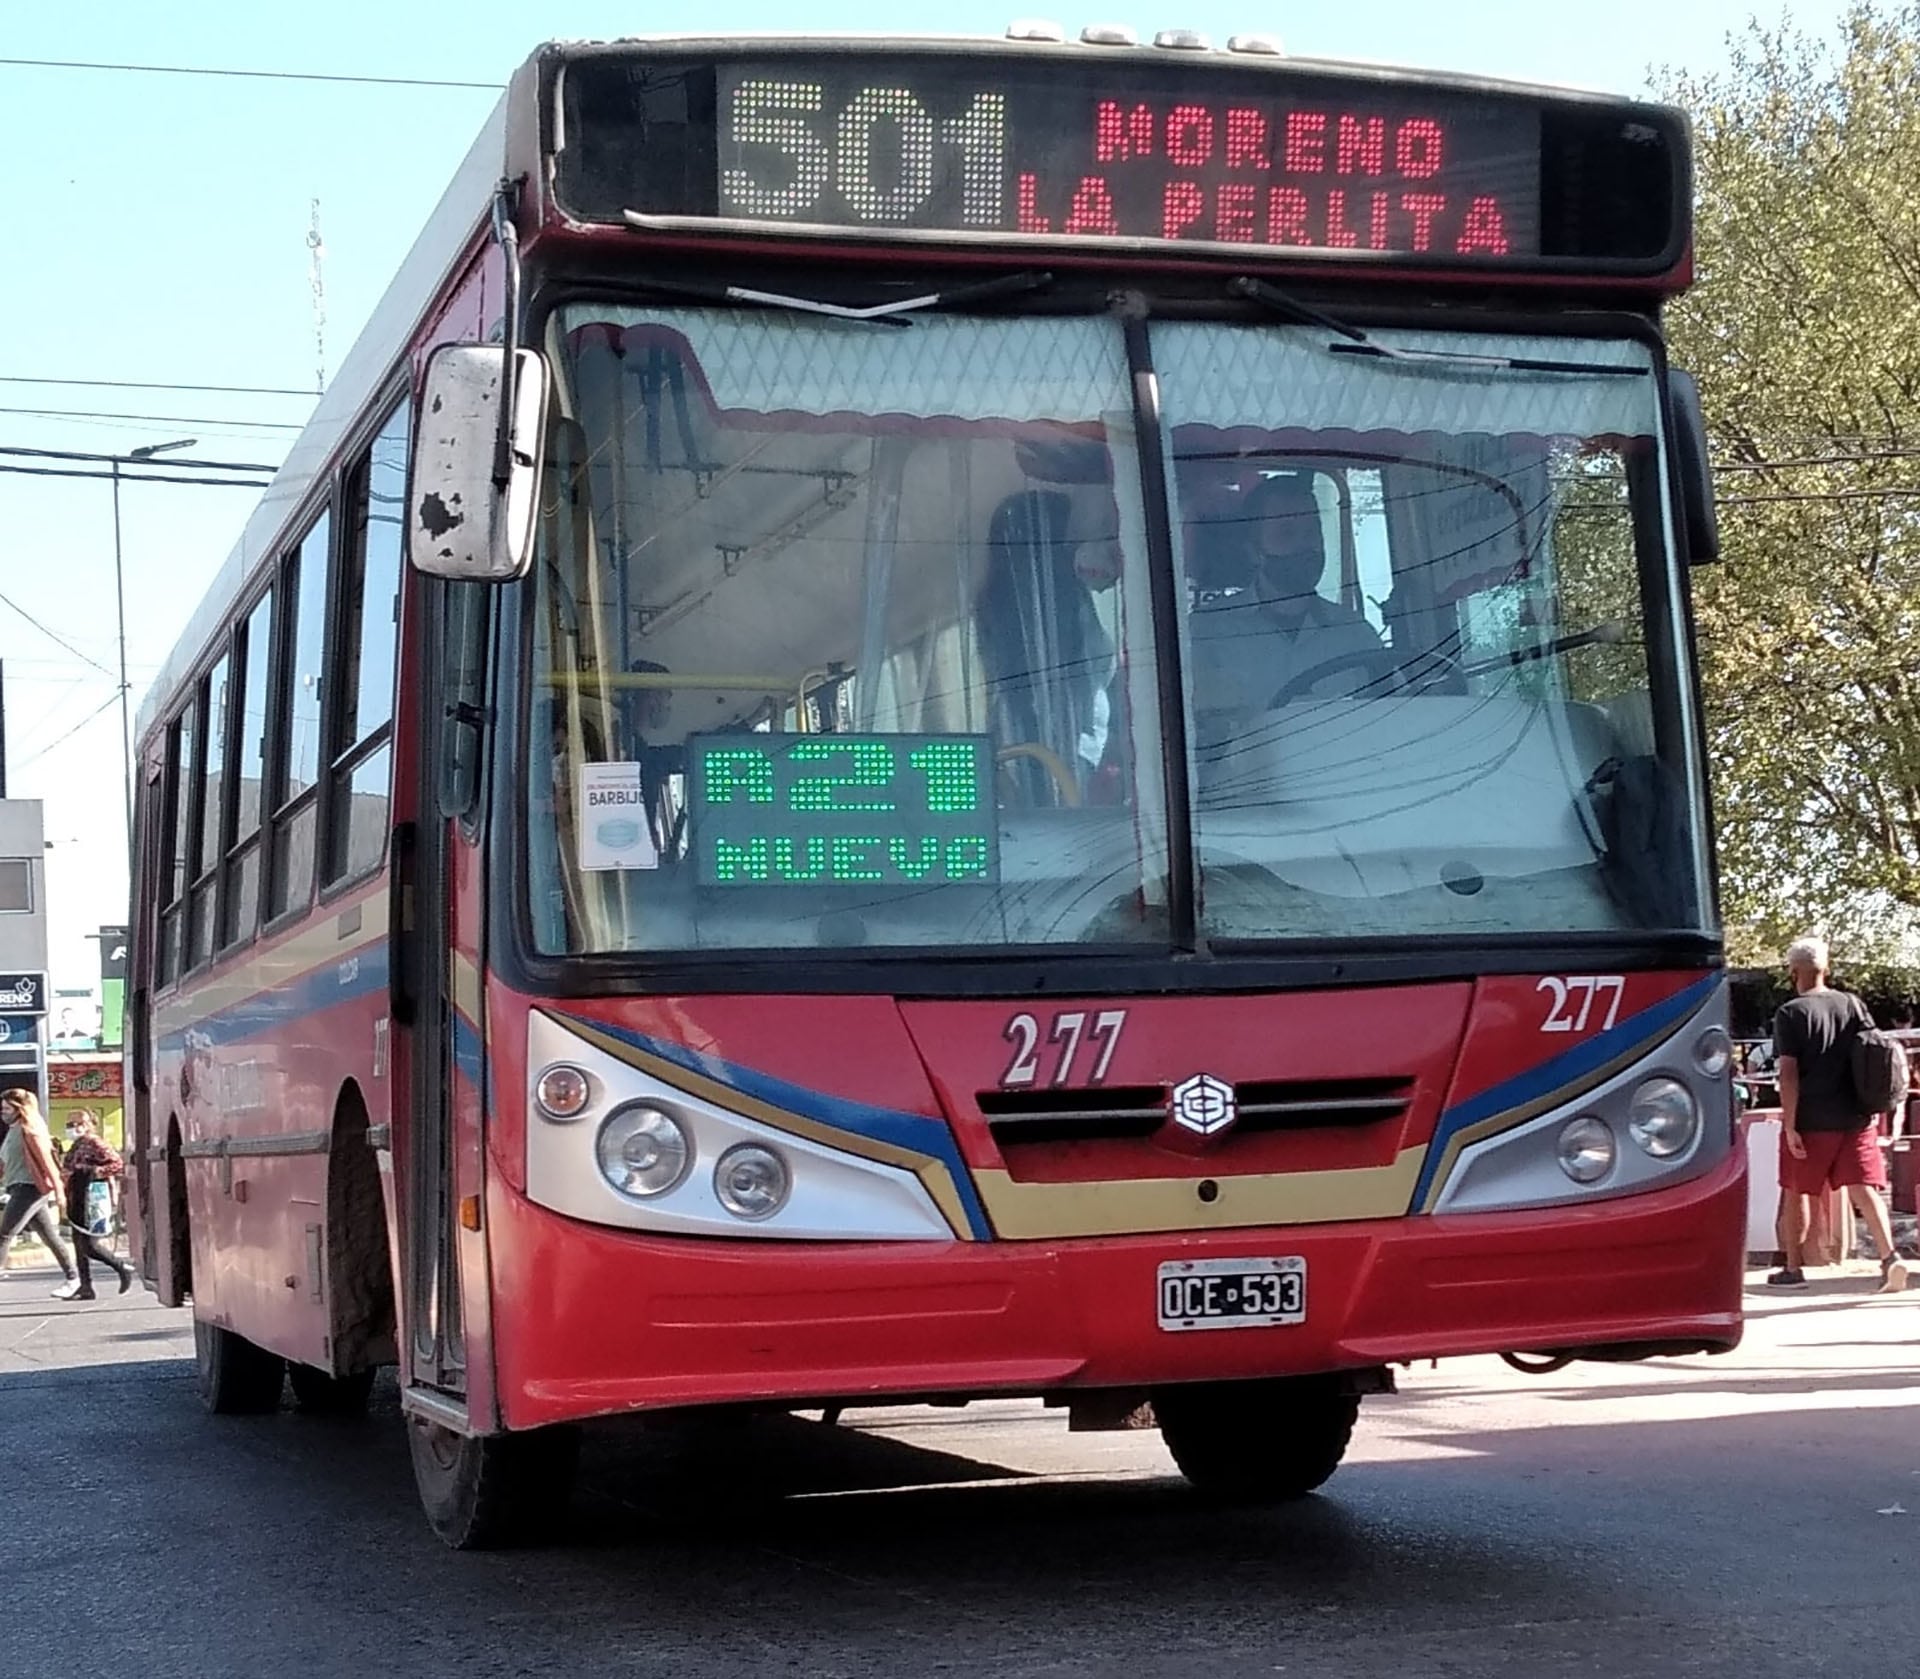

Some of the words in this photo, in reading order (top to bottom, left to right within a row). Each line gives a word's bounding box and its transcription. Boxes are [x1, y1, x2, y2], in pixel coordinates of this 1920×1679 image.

[723, 79, 1004, 225] 501
[1096, 101, 1444, 179] MORENO
[1017, 172, 1119, 236] LA
[1161, 180, 1511, 256] PERLITA
[1536, 975, 1626, 1032] 277
[1003, 1010, 1126, 1084] 277
[1164, 1277, 1222, 1317] OCE
[1242, 1273, 1300, 1313] 533
